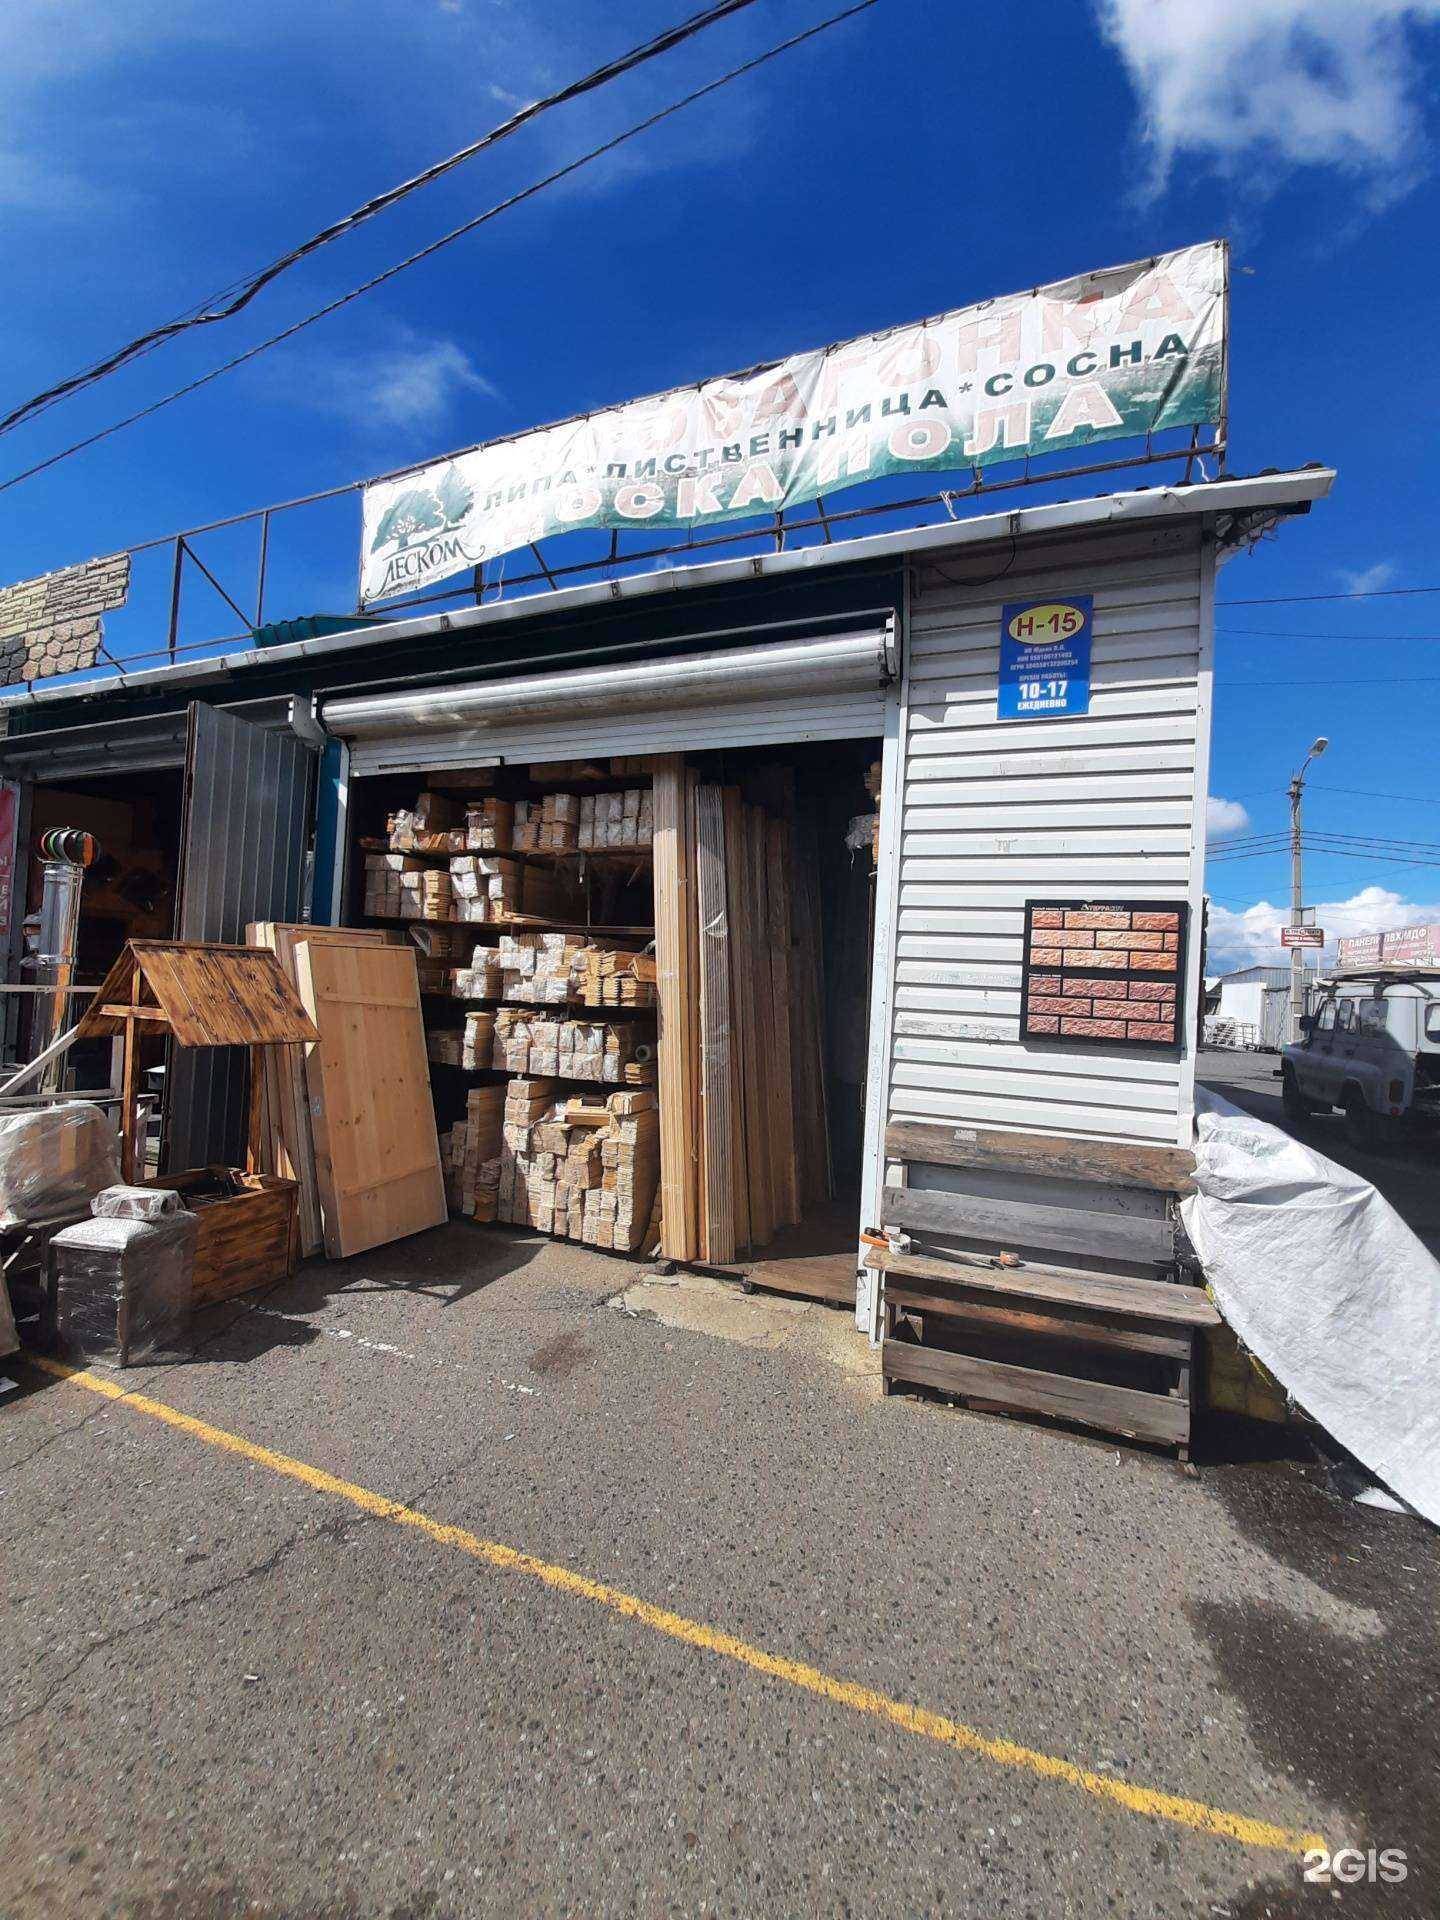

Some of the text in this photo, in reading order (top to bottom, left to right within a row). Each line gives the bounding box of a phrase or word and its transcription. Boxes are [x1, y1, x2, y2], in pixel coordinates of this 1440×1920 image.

[985, 333, 1188, 397] СОСНА
[365, 537, 485, 599] ЛЕСКОМ
[1016, 611, 1077, 637] Н-15
[1019, 680, 1068, 700] 10-17
[1017, 698, 1067, 711] ЕЖЕДНЕВНО
